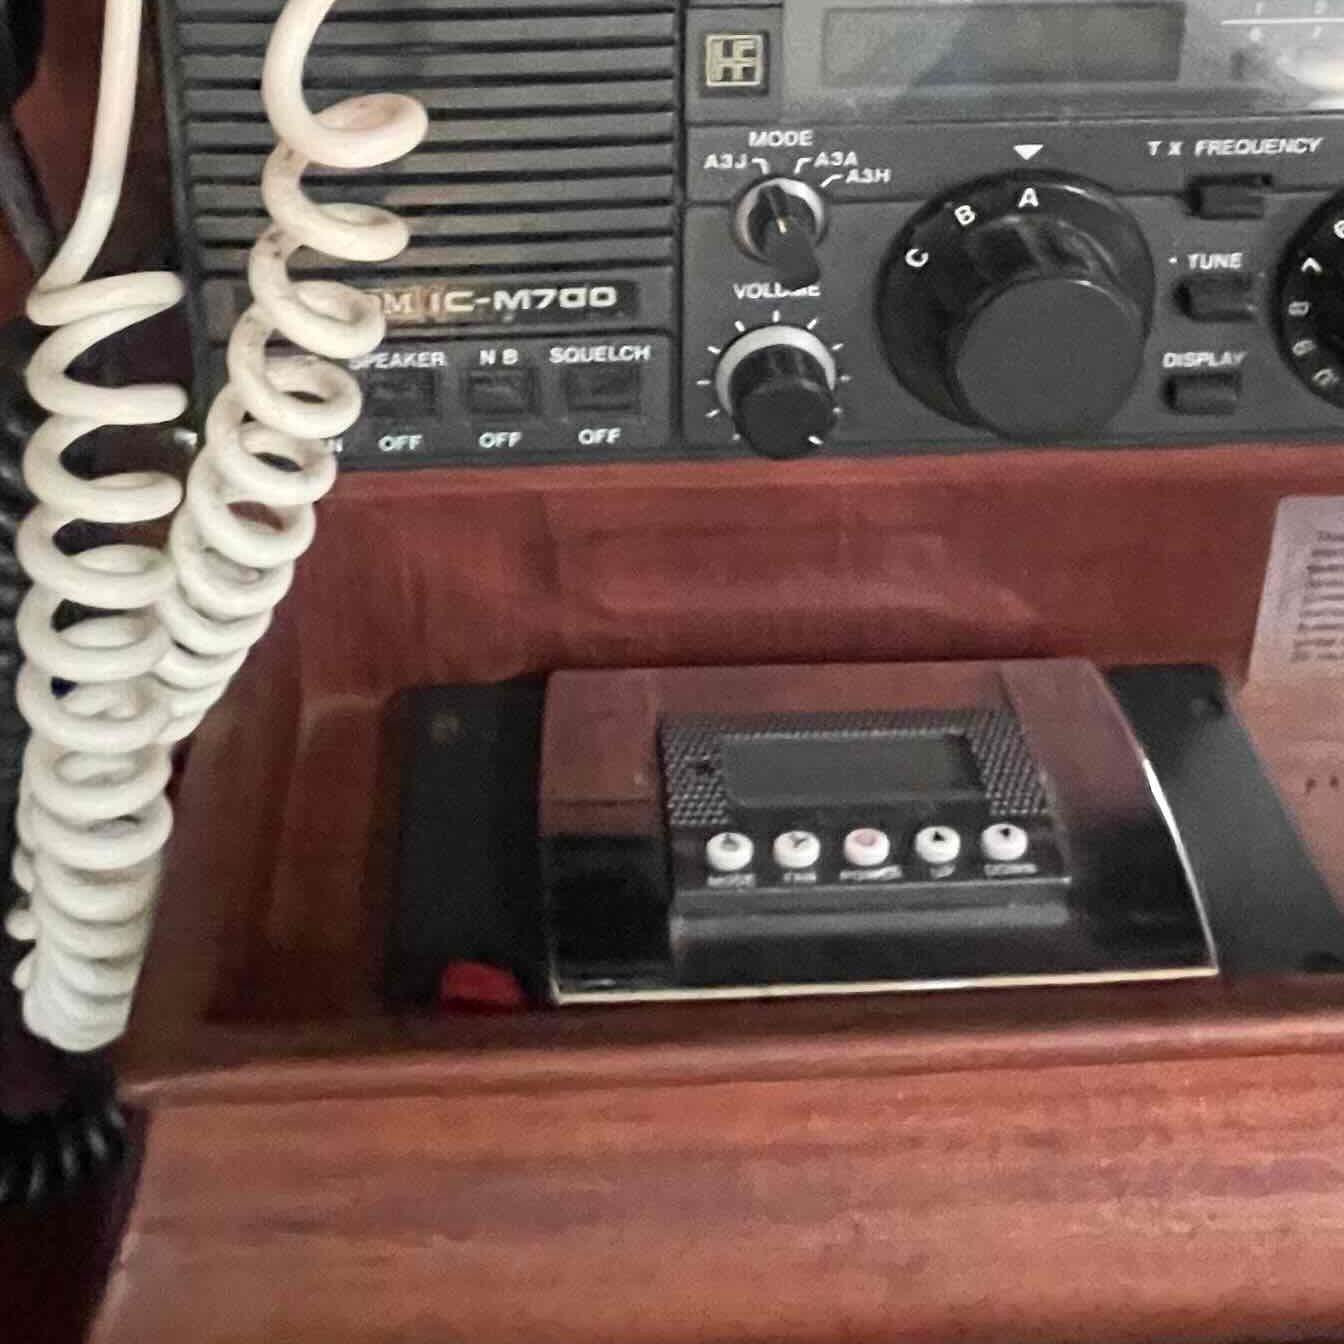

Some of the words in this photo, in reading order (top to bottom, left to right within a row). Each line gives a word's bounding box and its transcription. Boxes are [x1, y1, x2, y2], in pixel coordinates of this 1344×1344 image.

[749, 130, 813, 146] MODE
[1195, 137, 1323, 156] FREQUENCY
[704, 154, 747, 169] A3J
[814, 153, 858, 167] A3A
[845, 169, 891, 183] A3H
[1018, 187, 1039, 208] A
[955, 204, 976, 226] B
[905, 248, 928, 267] C
[1187, 253, 1243, 269] TUNE
[1301, 256, 1322, 273] 7
[431, 285, 619, 312] IC-M700
[549, 344, 653, 364] SQUELCH
[1162, 352, 1247, 368] DISPLAY
[378, 434, 423, 452] OFF
[478, 431, 523, 449] OFF
[577, 427, 622, 445] OFF
